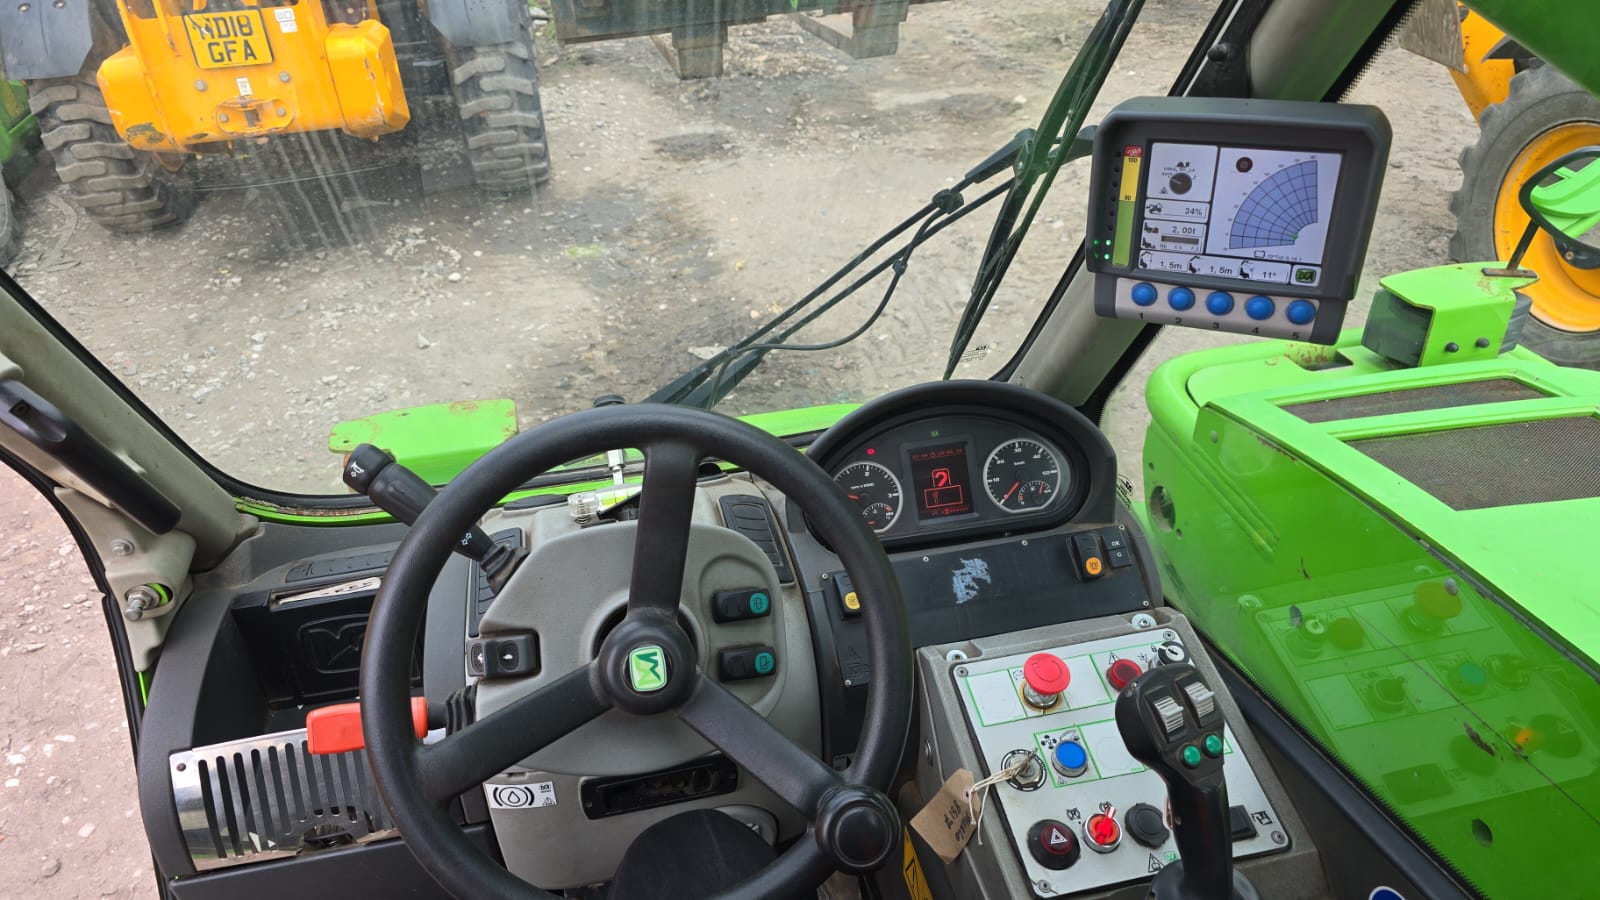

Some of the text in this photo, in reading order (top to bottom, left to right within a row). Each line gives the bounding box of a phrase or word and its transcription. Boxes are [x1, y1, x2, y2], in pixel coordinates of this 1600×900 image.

[190, 15, 253, 40] ND18
[207, 39, 258, 63] GFA
[1184, 207, 1202, 216] 34%
